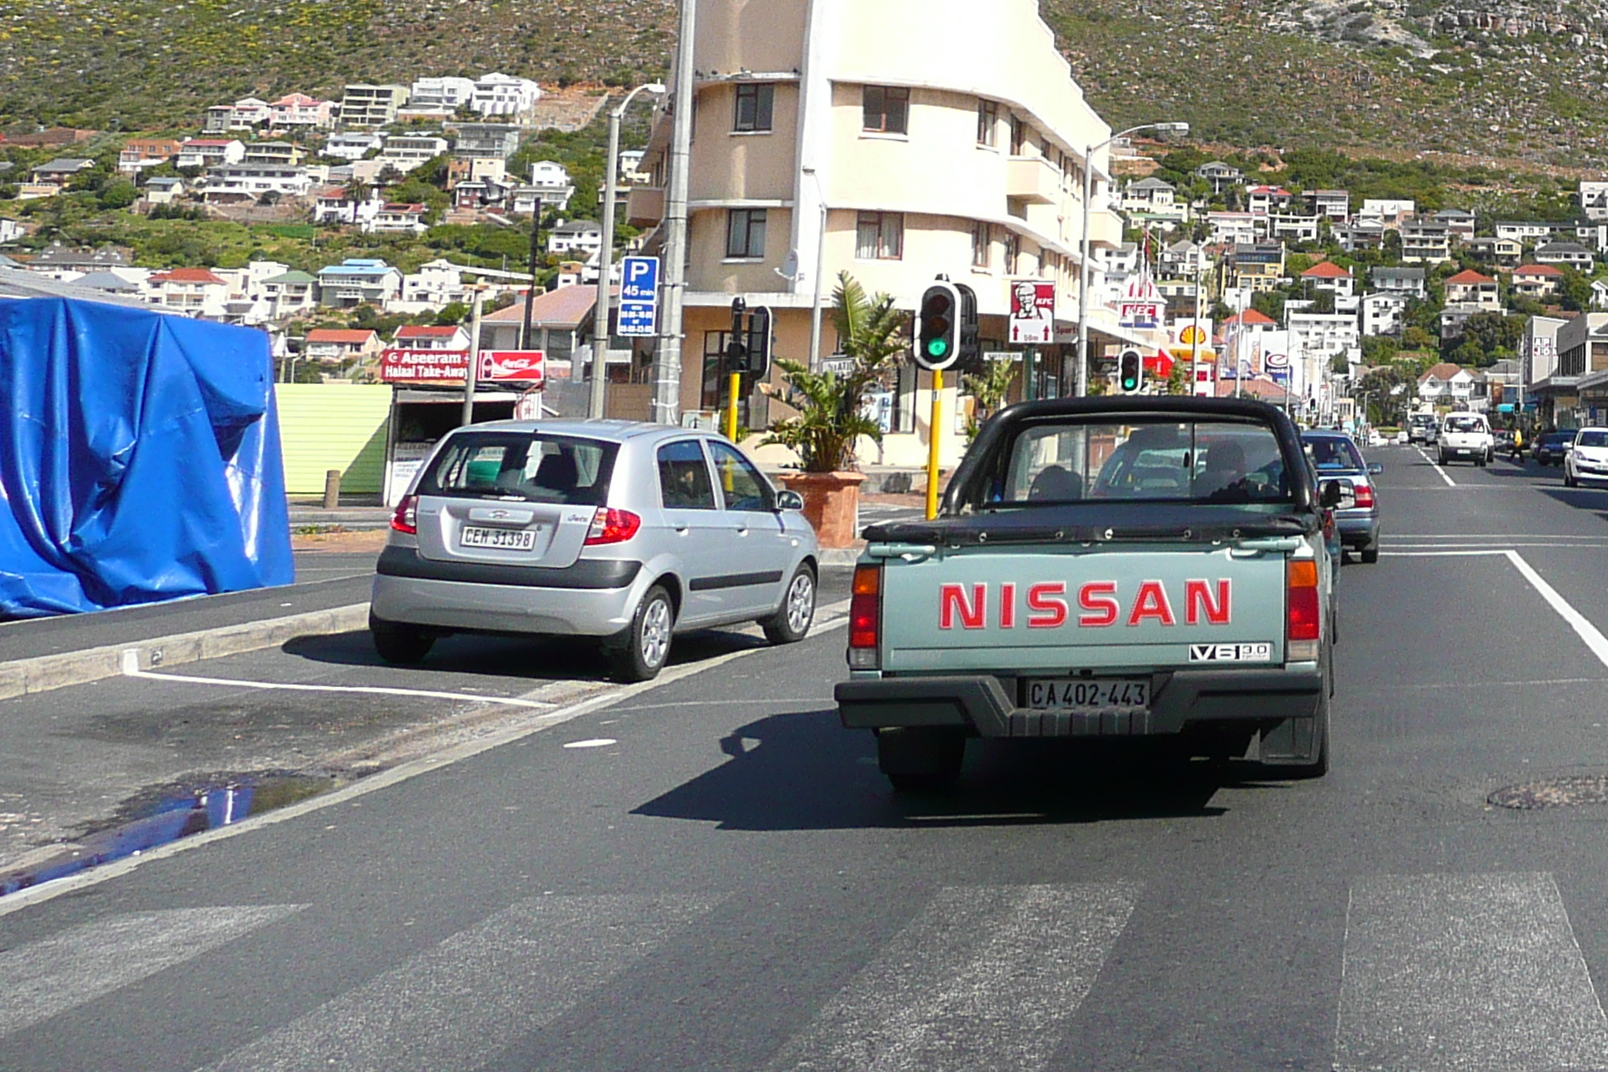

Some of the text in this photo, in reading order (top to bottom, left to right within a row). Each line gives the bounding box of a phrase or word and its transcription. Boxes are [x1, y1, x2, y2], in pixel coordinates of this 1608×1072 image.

[630, 261, 649, 282] P
[623, 285, 639, 296] 45
[401, 352, 461, 364] Aseeram
[493, 531, 530, 546] 31398
[938, 578, 1232, 628] NISSAN
[1031, 683, 1057, 706] CA
